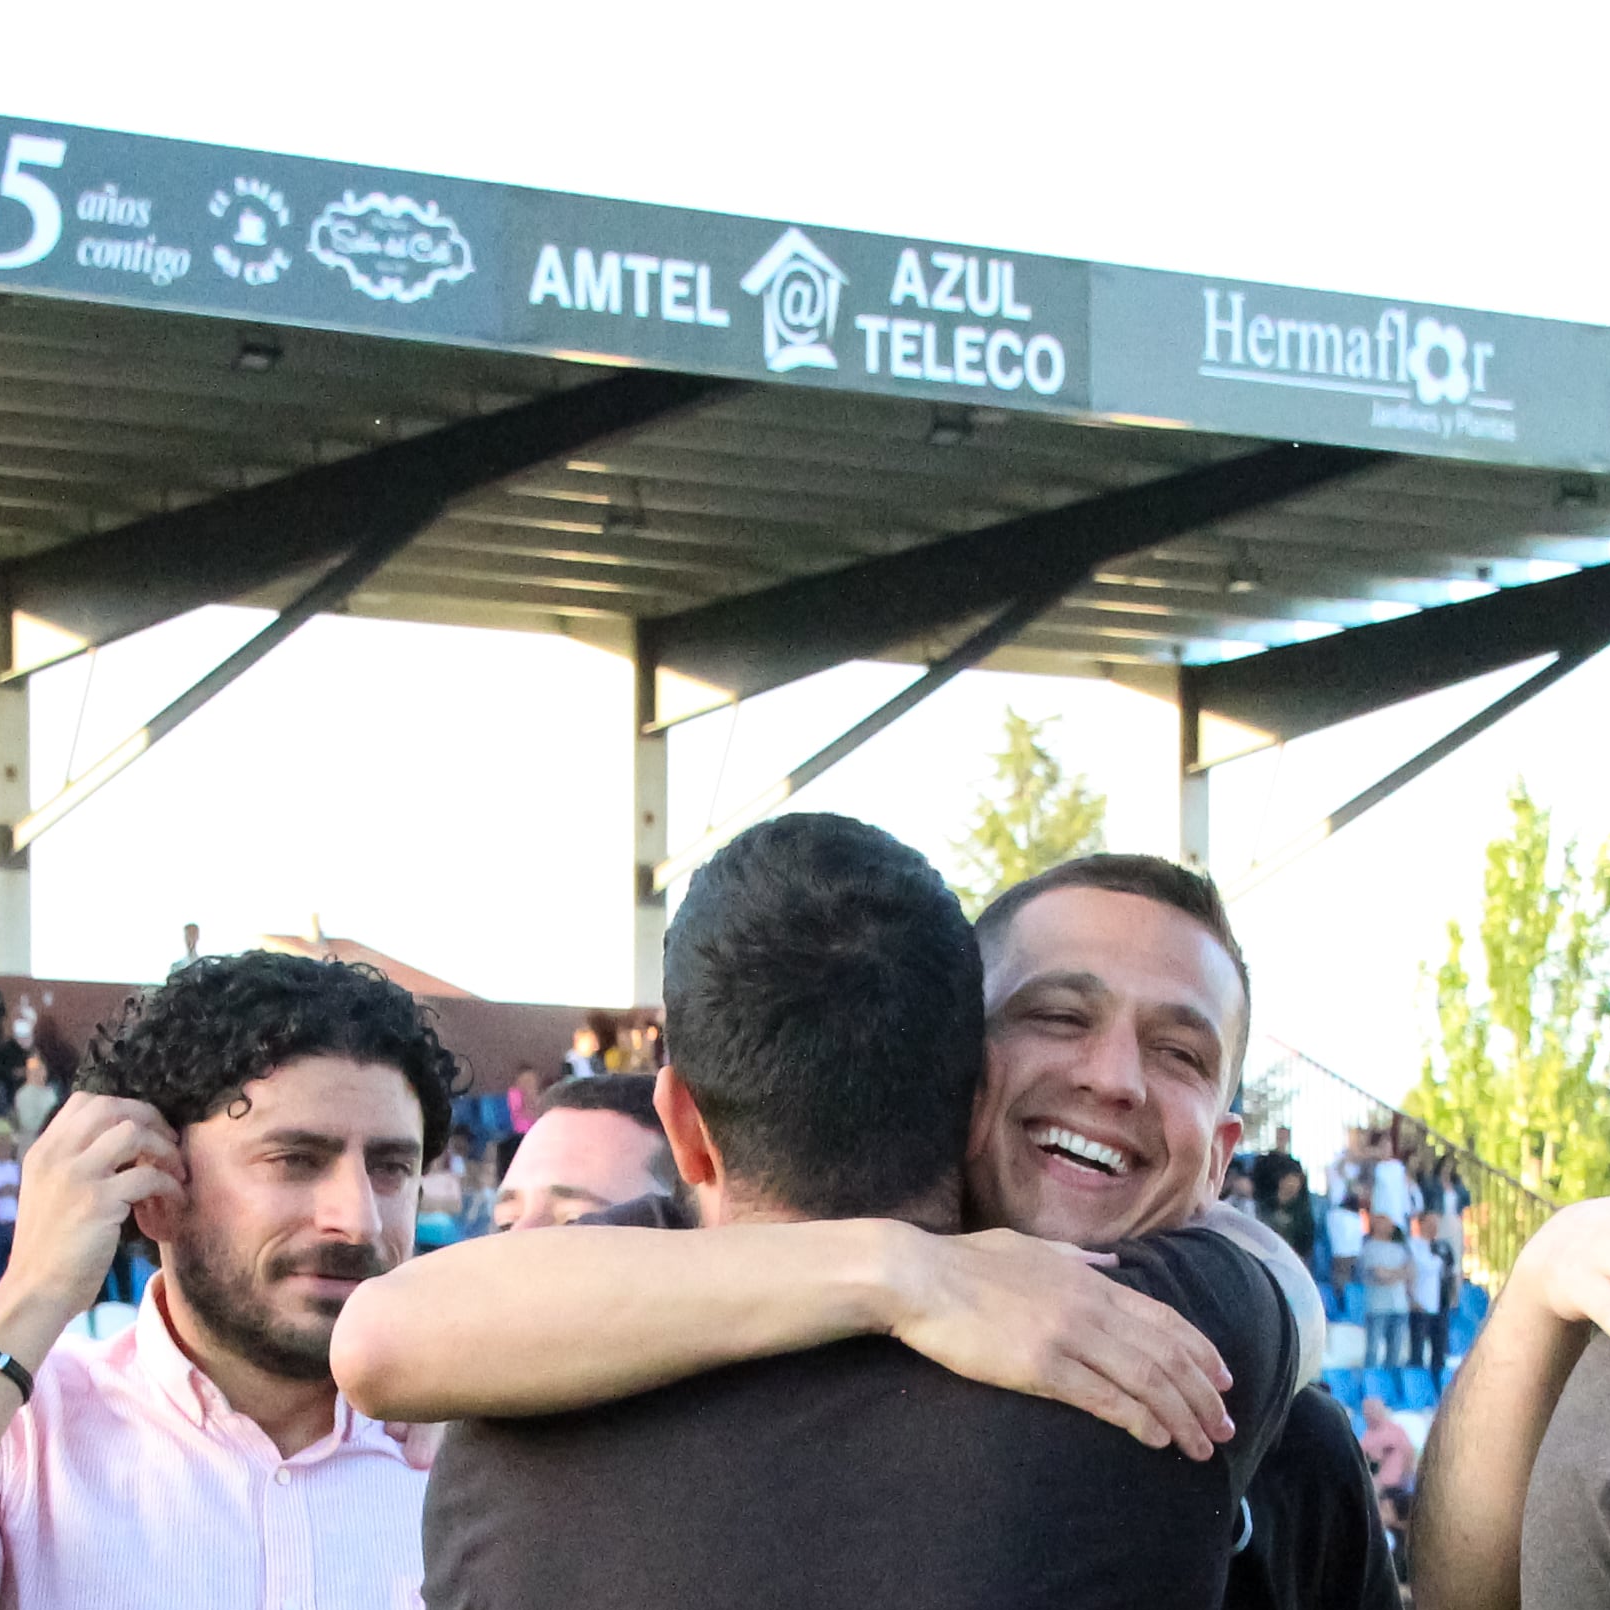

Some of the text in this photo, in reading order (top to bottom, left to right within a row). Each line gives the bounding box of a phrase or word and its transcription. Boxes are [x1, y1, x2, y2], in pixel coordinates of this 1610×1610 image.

[76, 182, 152, 228] años
[76, 233, 192, 287] contigo
[528, 243, 731, 329] AMTEL
[890, 248, 1033, 322] AZUL
[854, 313, 1066, 396] TELECO
